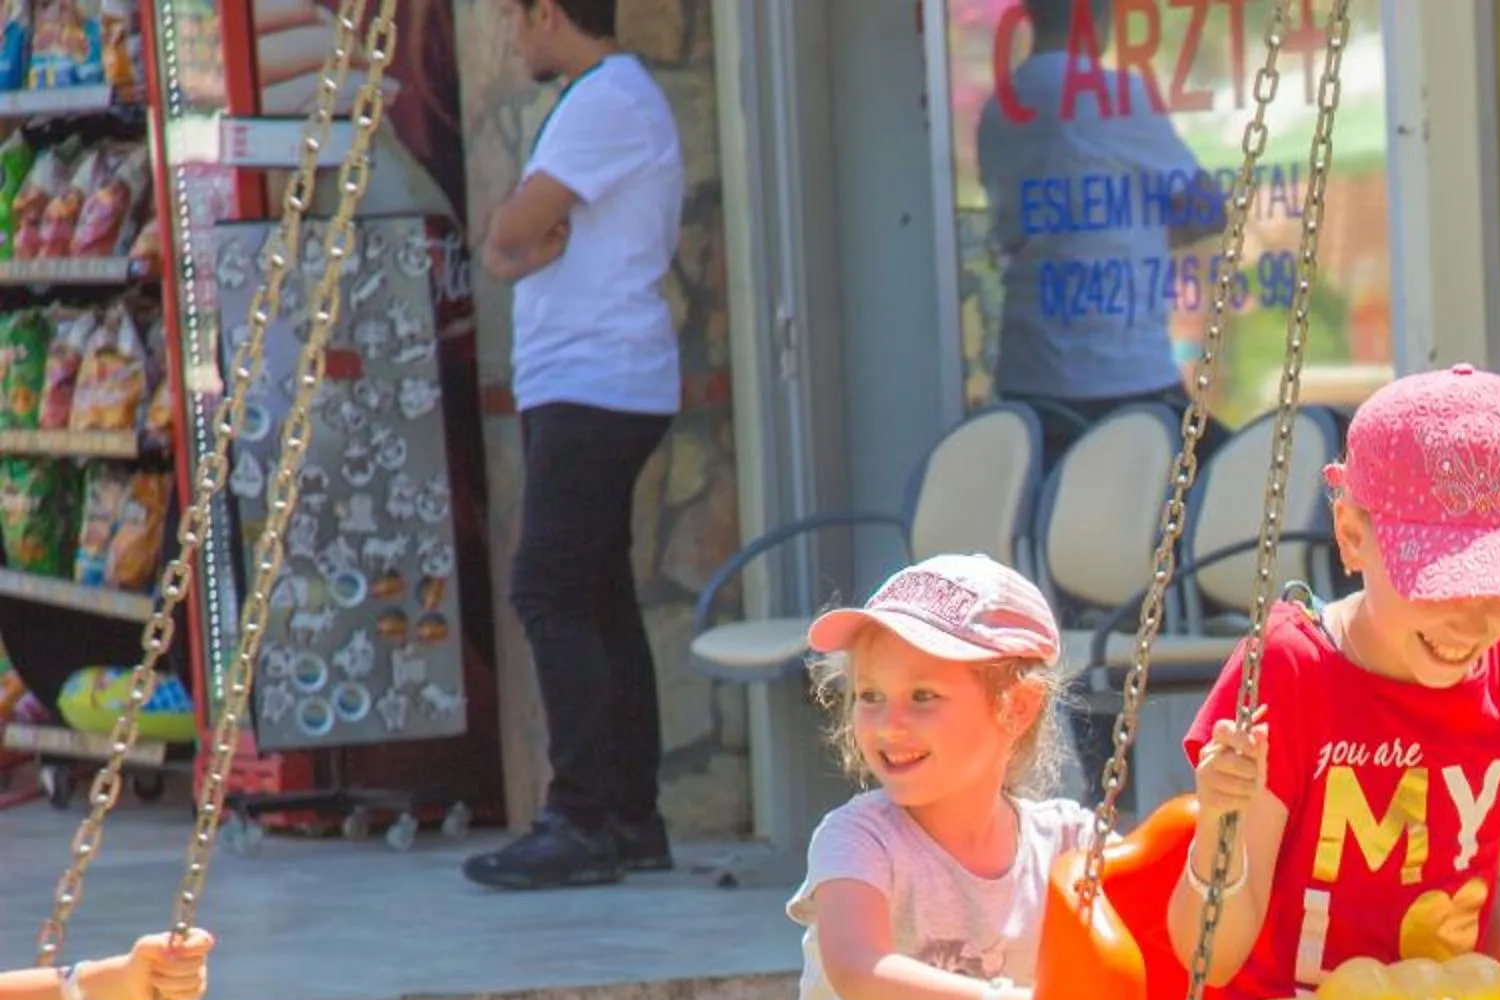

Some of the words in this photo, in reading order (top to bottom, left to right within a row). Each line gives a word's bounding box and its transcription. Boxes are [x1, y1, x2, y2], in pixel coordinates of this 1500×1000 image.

[1021, 173, 1131, 235] ESLEM
[1141, 162, 1303, 228] HOSPTAL
[1143, 254, 1200, 311] 746
[1258, 251, 1295, 308] 99
[1313, 740, 1371, 780] you
[1373, 737, 1424, 768] are
